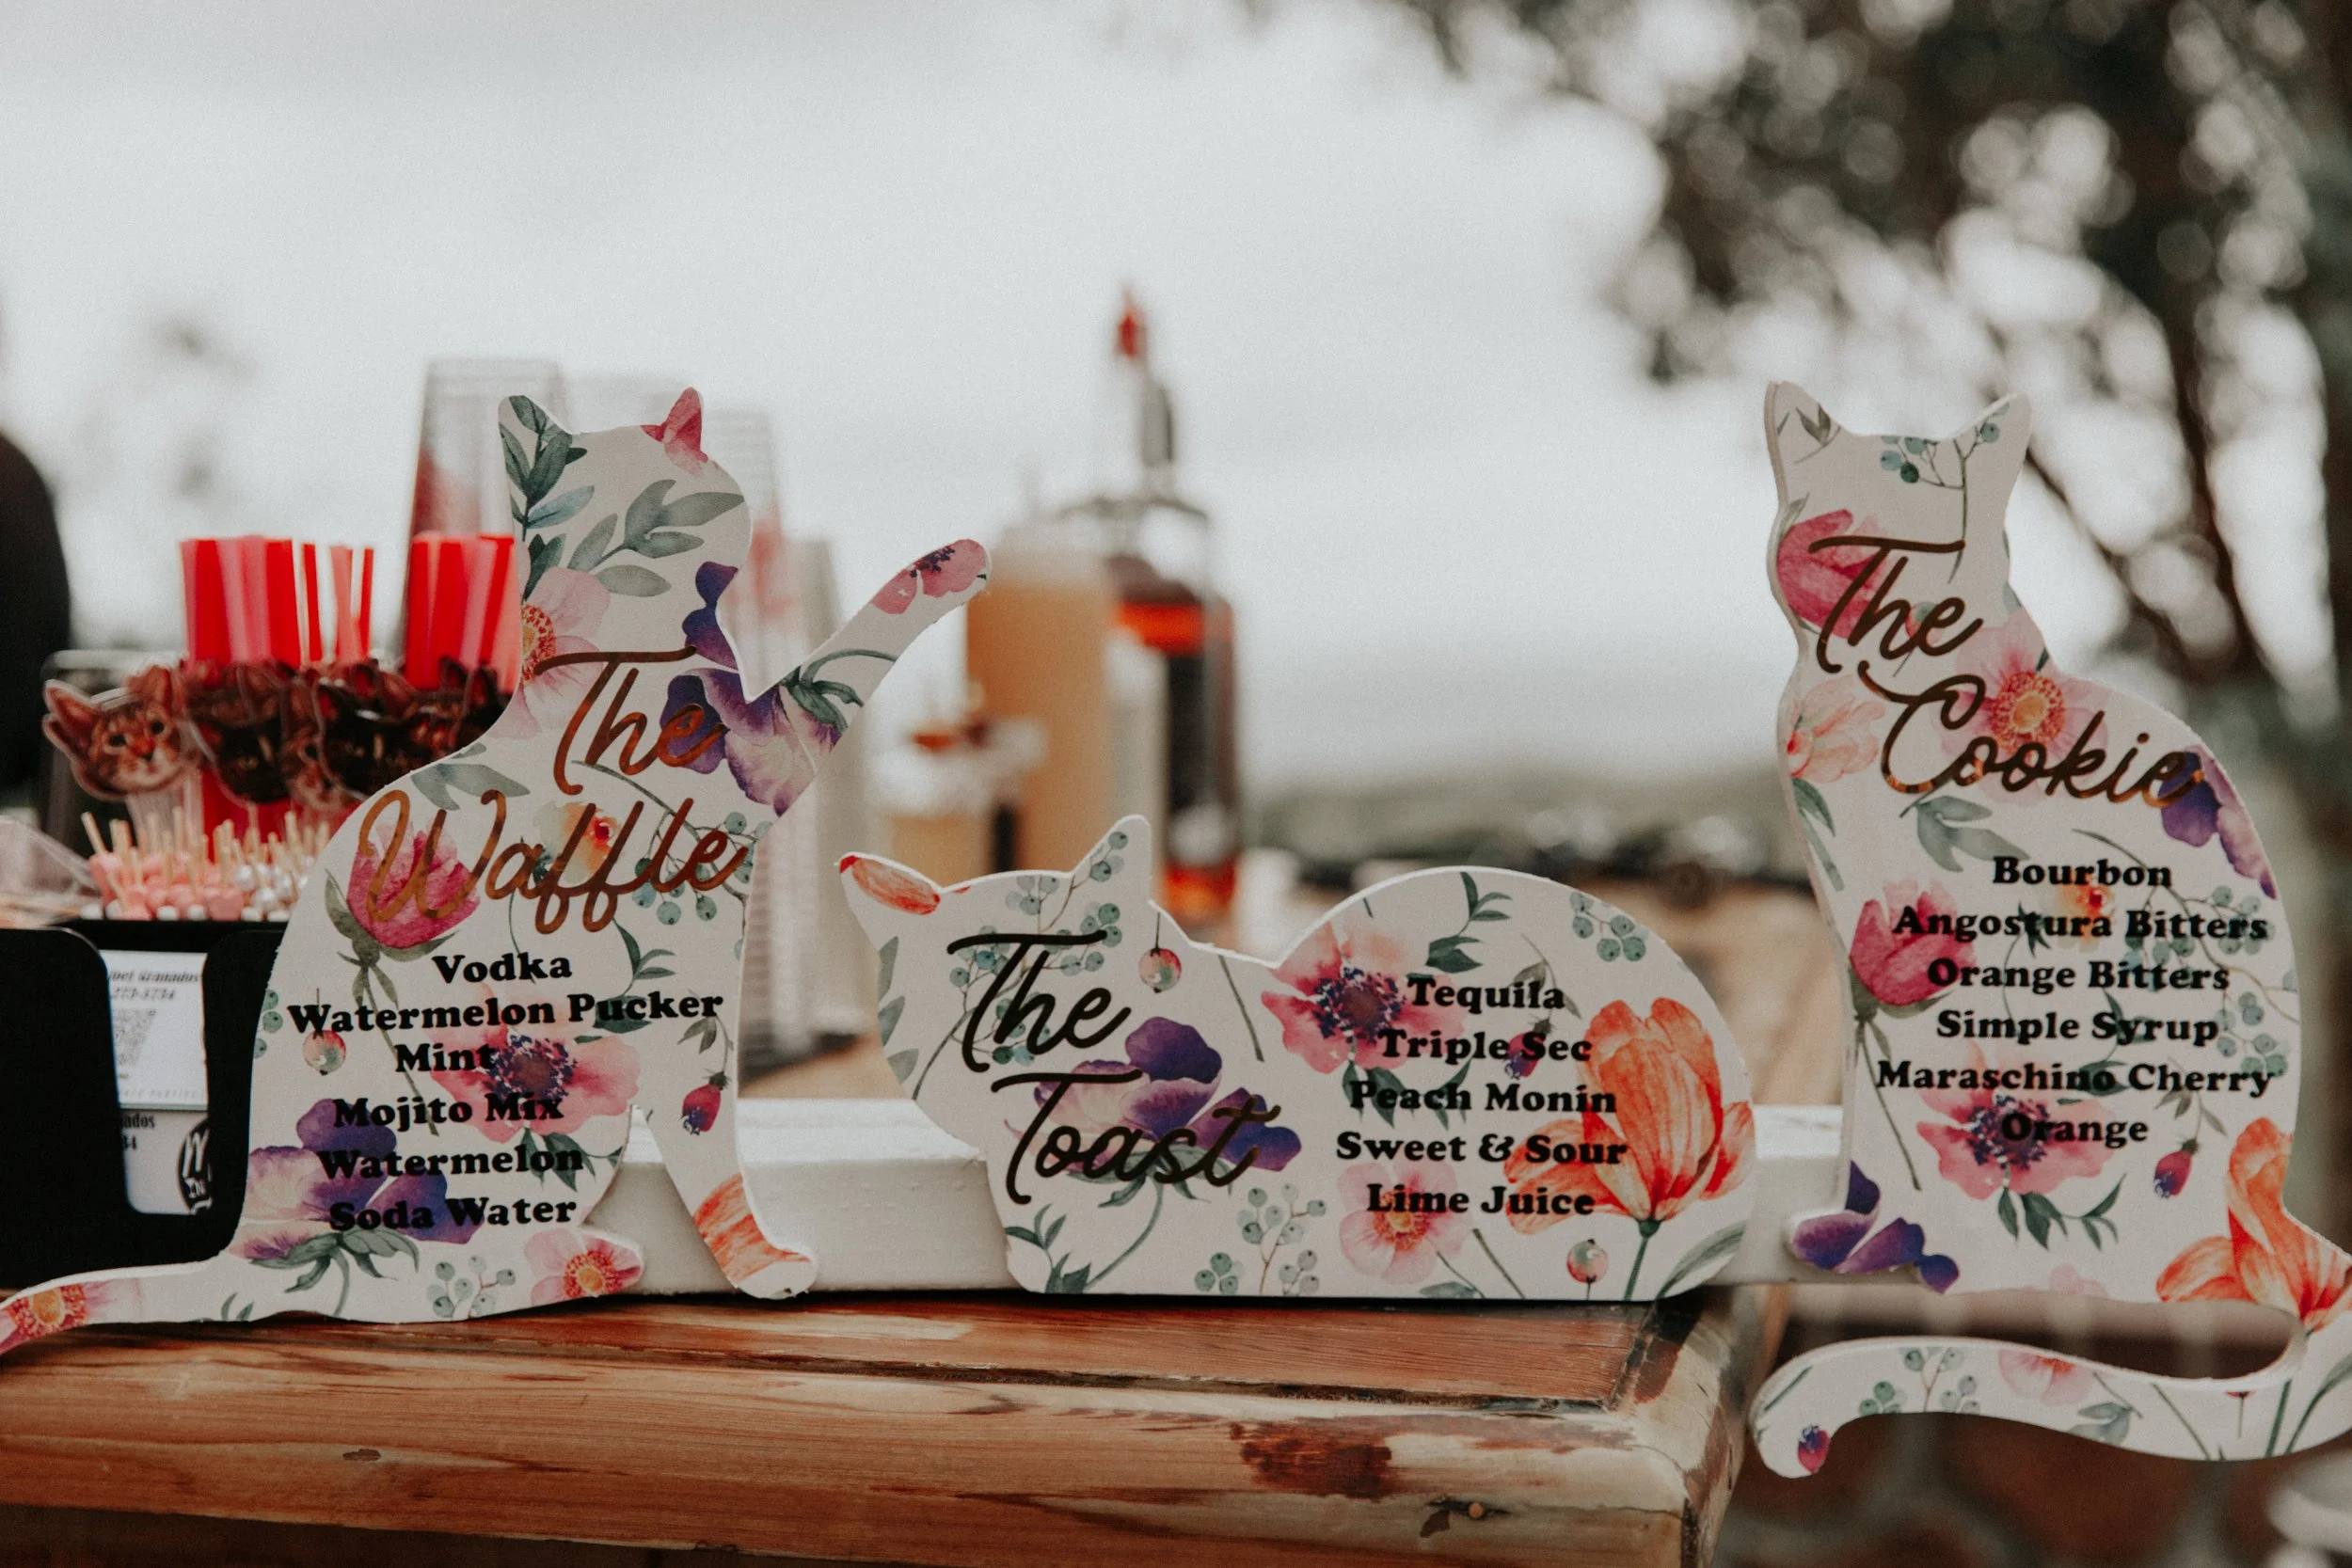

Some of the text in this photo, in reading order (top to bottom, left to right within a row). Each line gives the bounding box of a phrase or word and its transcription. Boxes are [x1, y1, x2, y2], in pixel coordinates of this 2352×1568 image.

[1808, 535, 1983, 673] The
[534, 645, 726, 795] The
[1857, 660, 2205, 809] Cookie
[358, 789, 750, 935] Waffle
[1993, 857, 2172, 887] Bourbon
[1892, 906, 2268, 942] Angostura Bitters
[432, 953, 572, 984] Vodka
[1927, 958, 2230, 994] Orange Bitters
[288, 990, 724, 1034] Watermelon Pucker
[946, 929, 1132, 1073] The
[1407, 976, 1565, 1015] Tequila
[1937, 1010, 2219, 1045] Simple Syrup
[394, 1042, 497, 1073] Mint
[1378, 1028, 1593, 1065] Triple Sec
[1350, 1080, 1617, 1113] Peach Monin
[1876, 1060, 2279, 1098] Maraschino Cherry
[333, 1092, 564, 1132] Mojito Mix
[2000, 1112, 2149, 1148] Orange
[991, 1069, 1282, 1205] Toast
[1337, 1131, 1627, 1164] Sweet & Sour
[316, 1147, 583, 1180] Watermelon
[329, 1197, 578, 1232] Soda Water
[1367, 1183, 1595, 1215] Lime Juice
